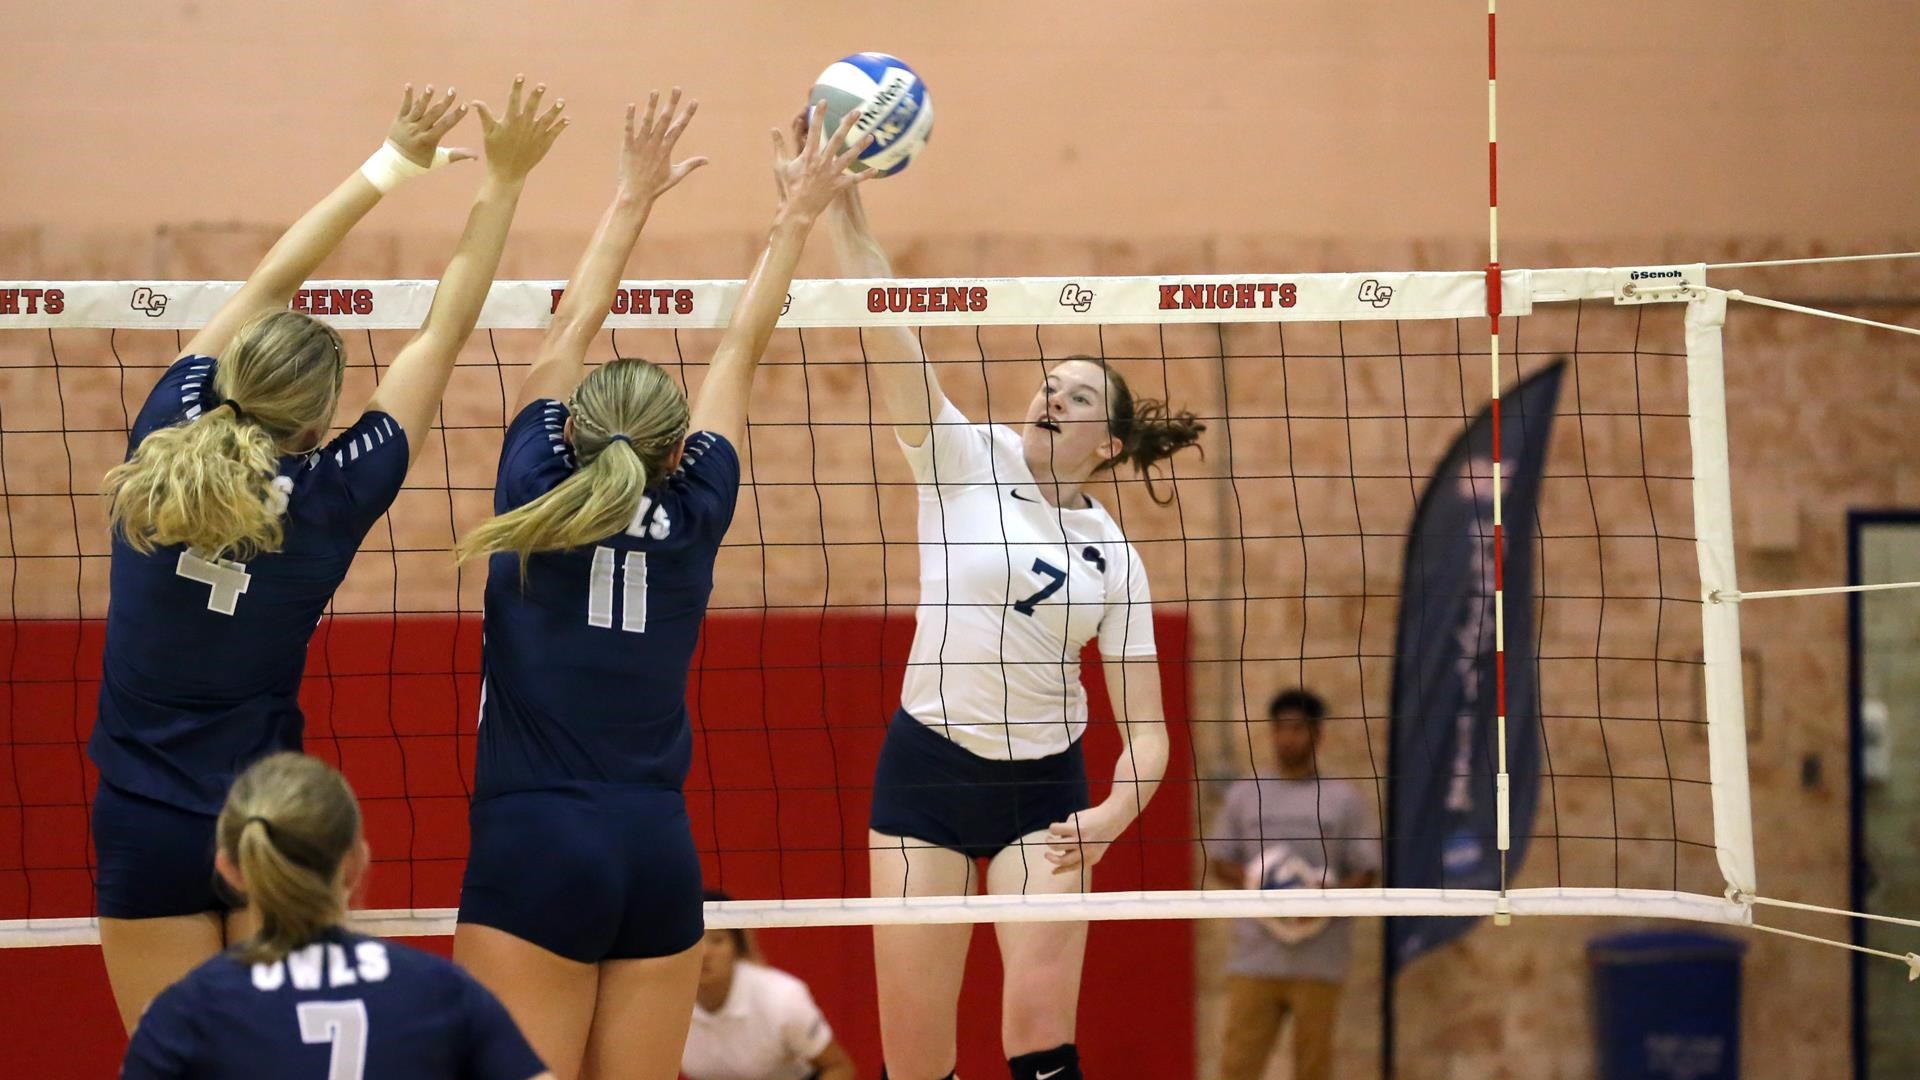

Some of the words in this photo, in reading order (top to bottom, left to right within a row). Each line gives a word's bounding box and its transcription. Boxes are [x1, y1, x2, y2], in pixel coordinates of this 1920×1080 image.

[292, 289, 373, 315] EENS
[551, 289, 693, 314] GHTS
[867, 287, 988, 312] QUEENS
[1159, 283, 1297, 309] KNIGHTS
[625, 496, 671, 540] LS
[588, 545, 648, 633] 11
[1014, 557, 1067, 617] 7
[252, 941, 390, 991] OWLS
[296, 999, 368, 1080] 7
